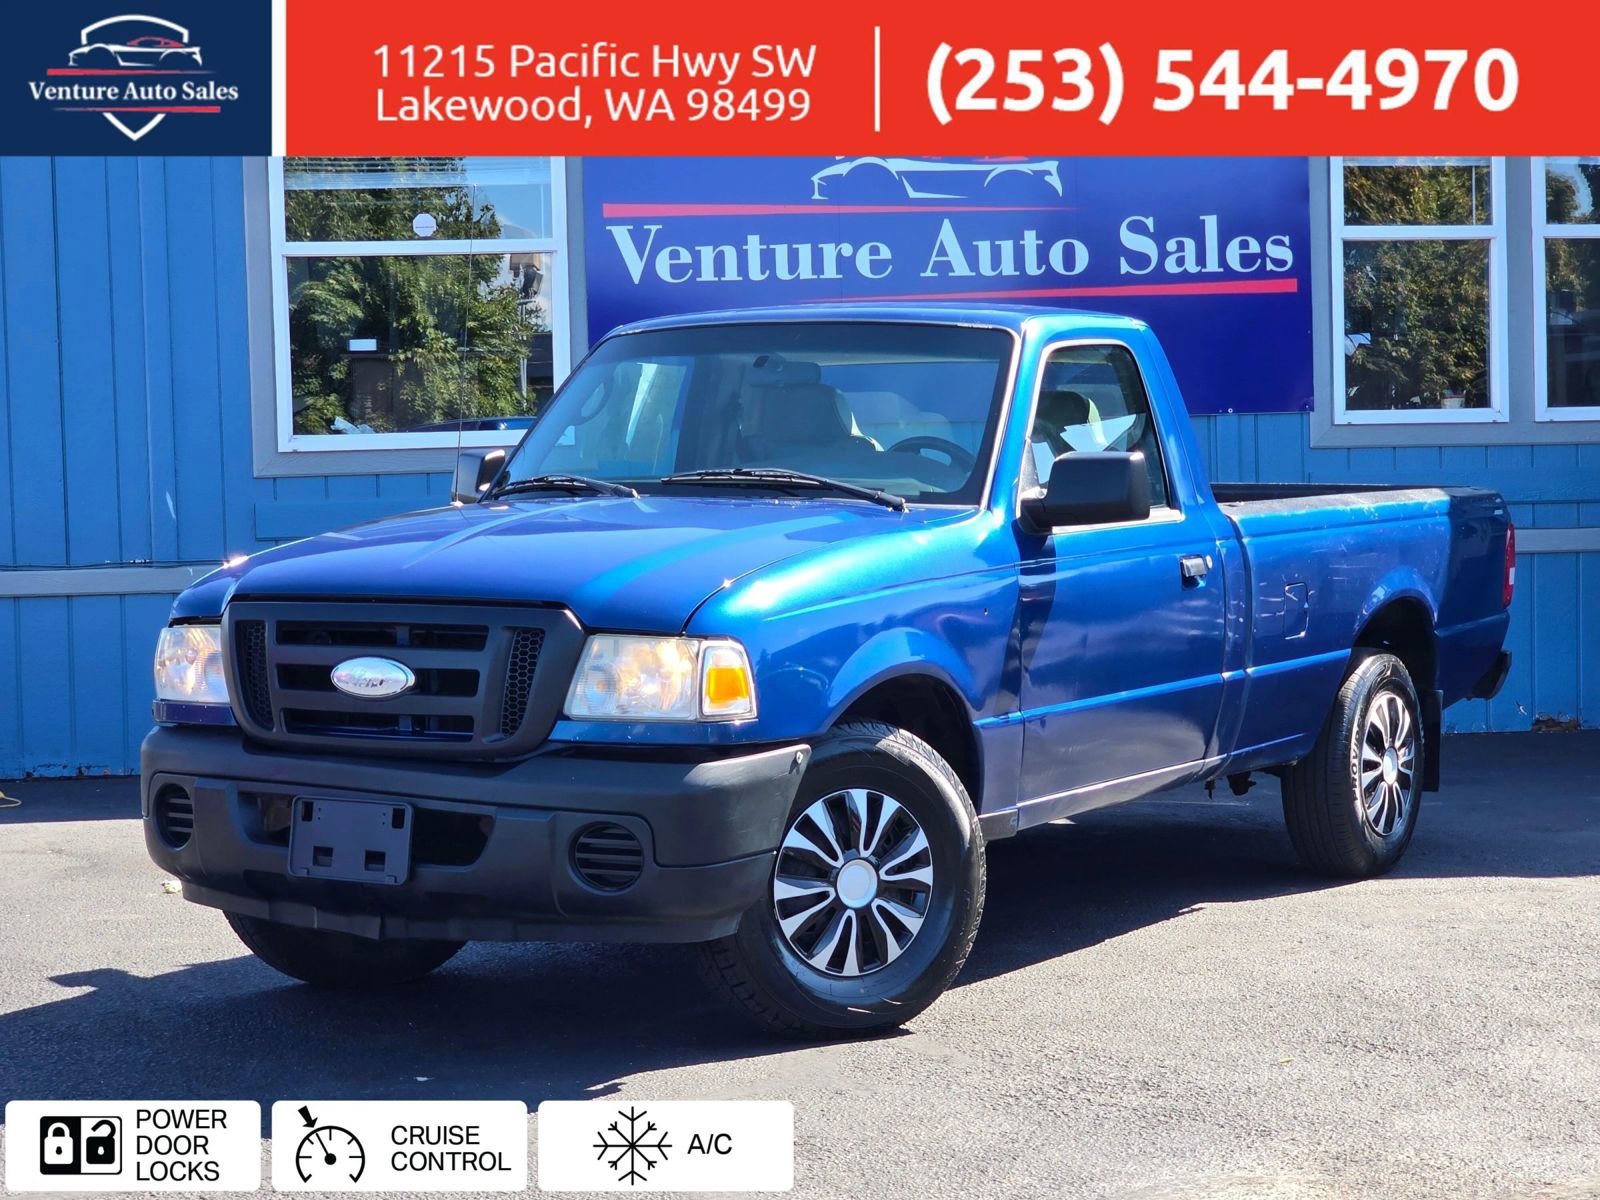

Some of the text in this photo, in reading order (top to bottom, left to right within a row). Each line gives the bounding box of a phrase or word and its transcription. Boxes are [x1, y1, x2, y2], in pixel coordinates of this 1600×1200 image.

[605, 214, 1293, 285] Venture Auto Sales
